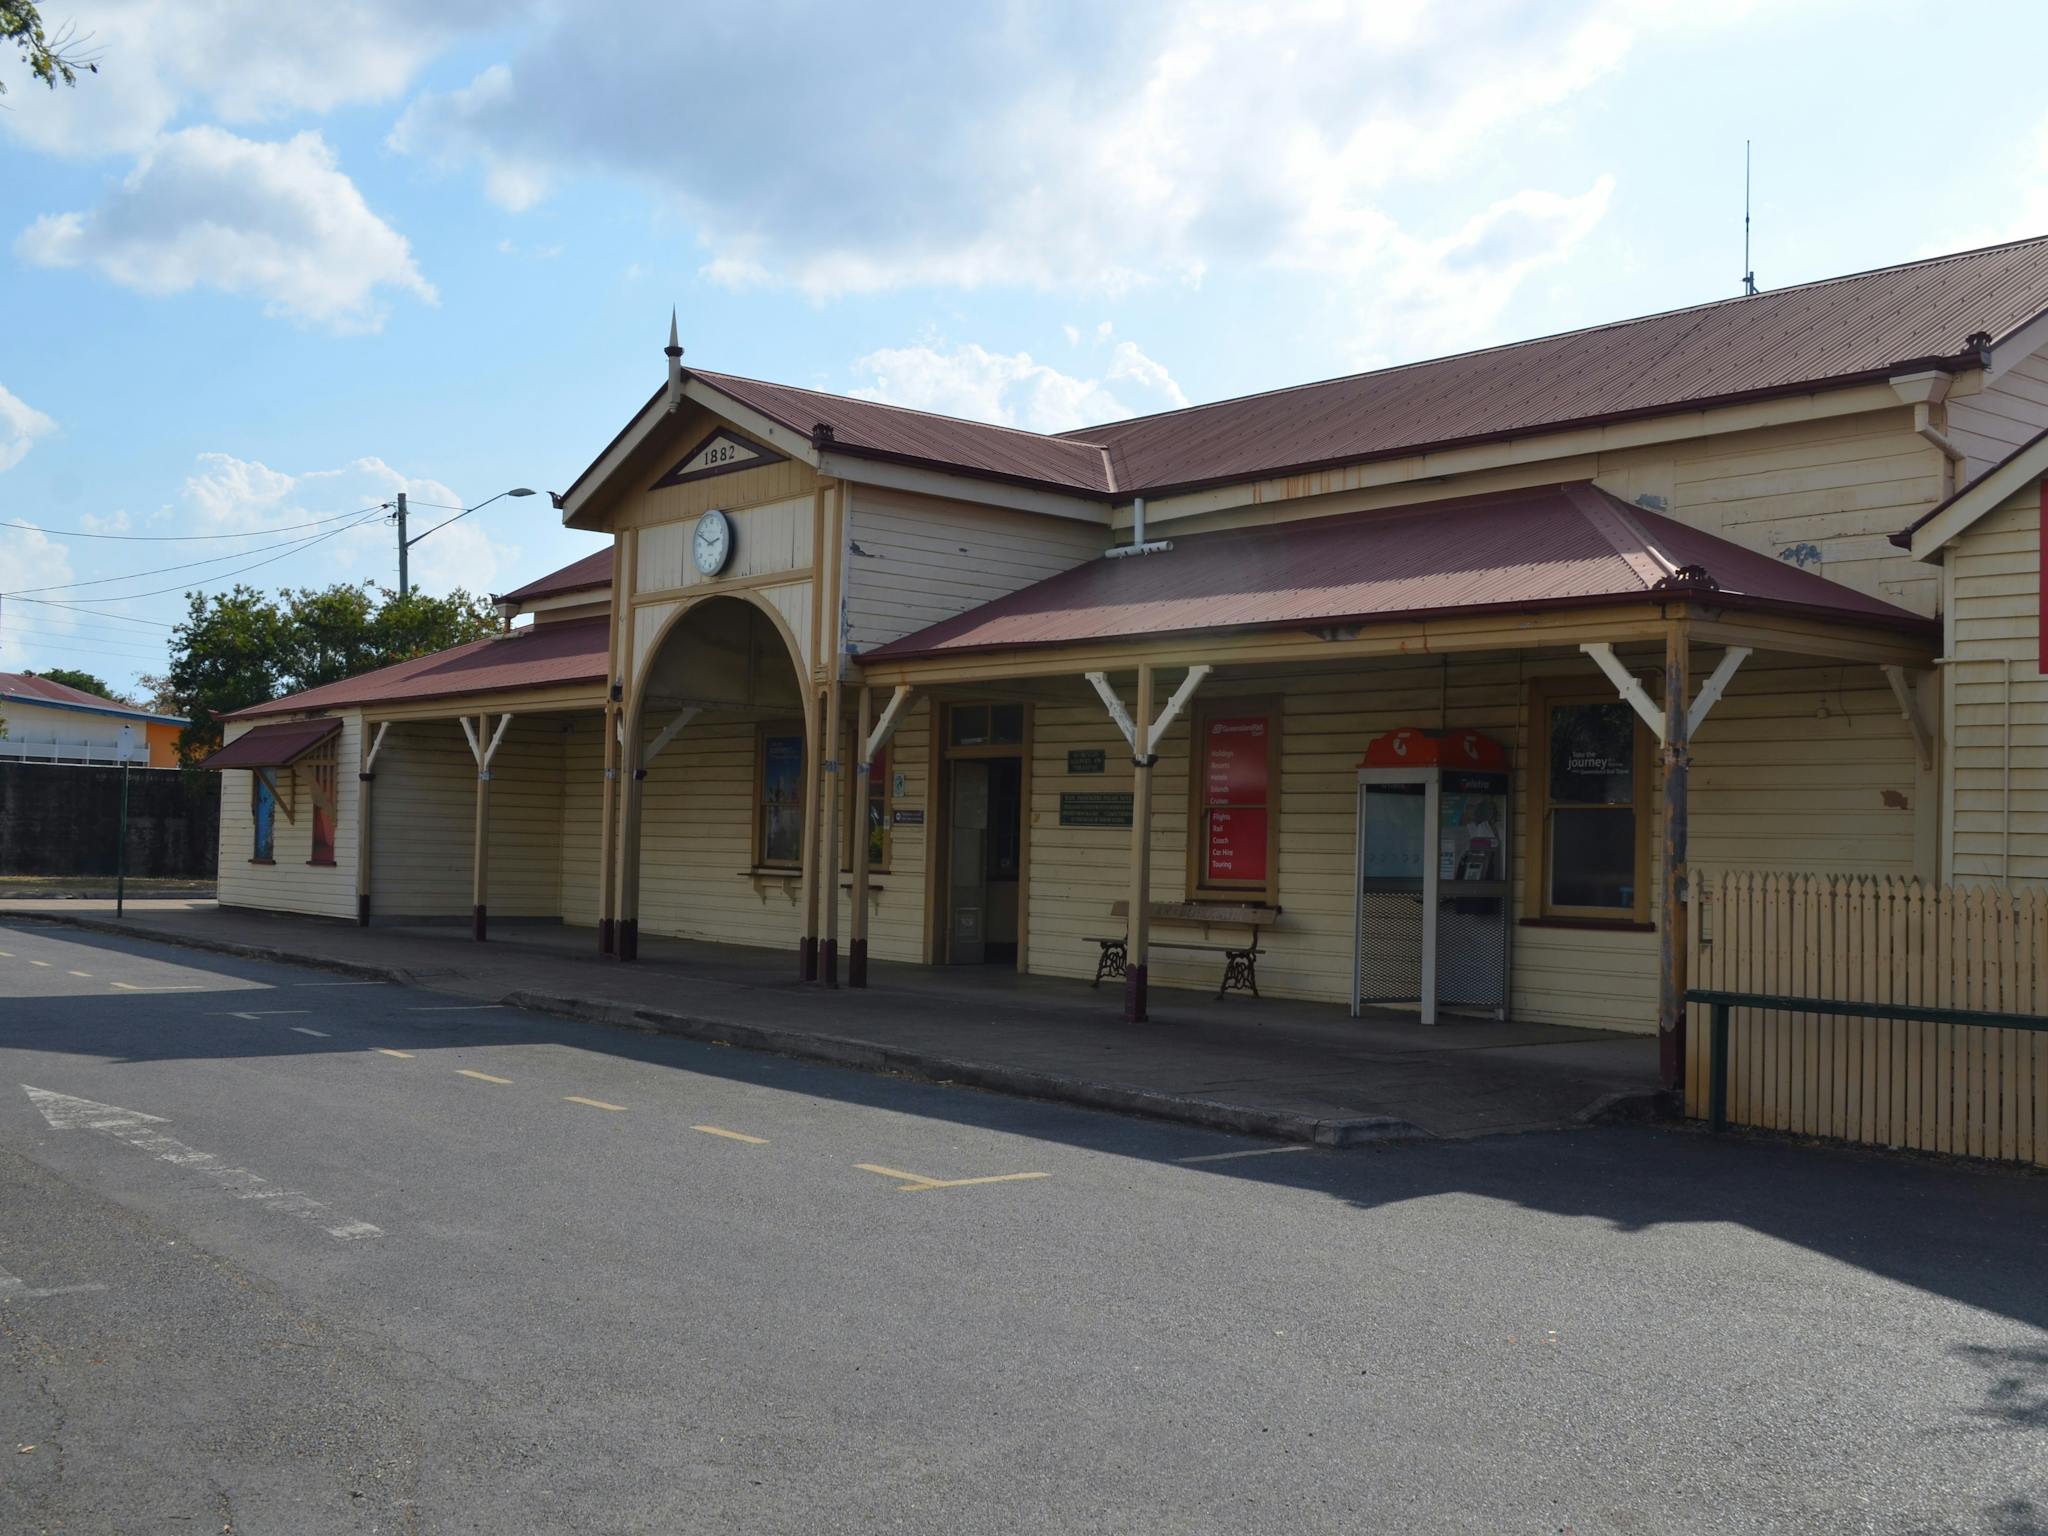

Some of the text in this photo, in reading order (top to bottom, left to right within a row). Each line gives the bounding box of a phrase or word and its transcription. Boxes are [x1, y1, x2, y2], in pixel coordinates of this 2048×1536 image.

[704, 445, 735, 466] 1882
[1567, 756, 1608, 770] journey
[1213, 813, 1230, 822] Flights
[1212, 860, 1232, 871] Touring
